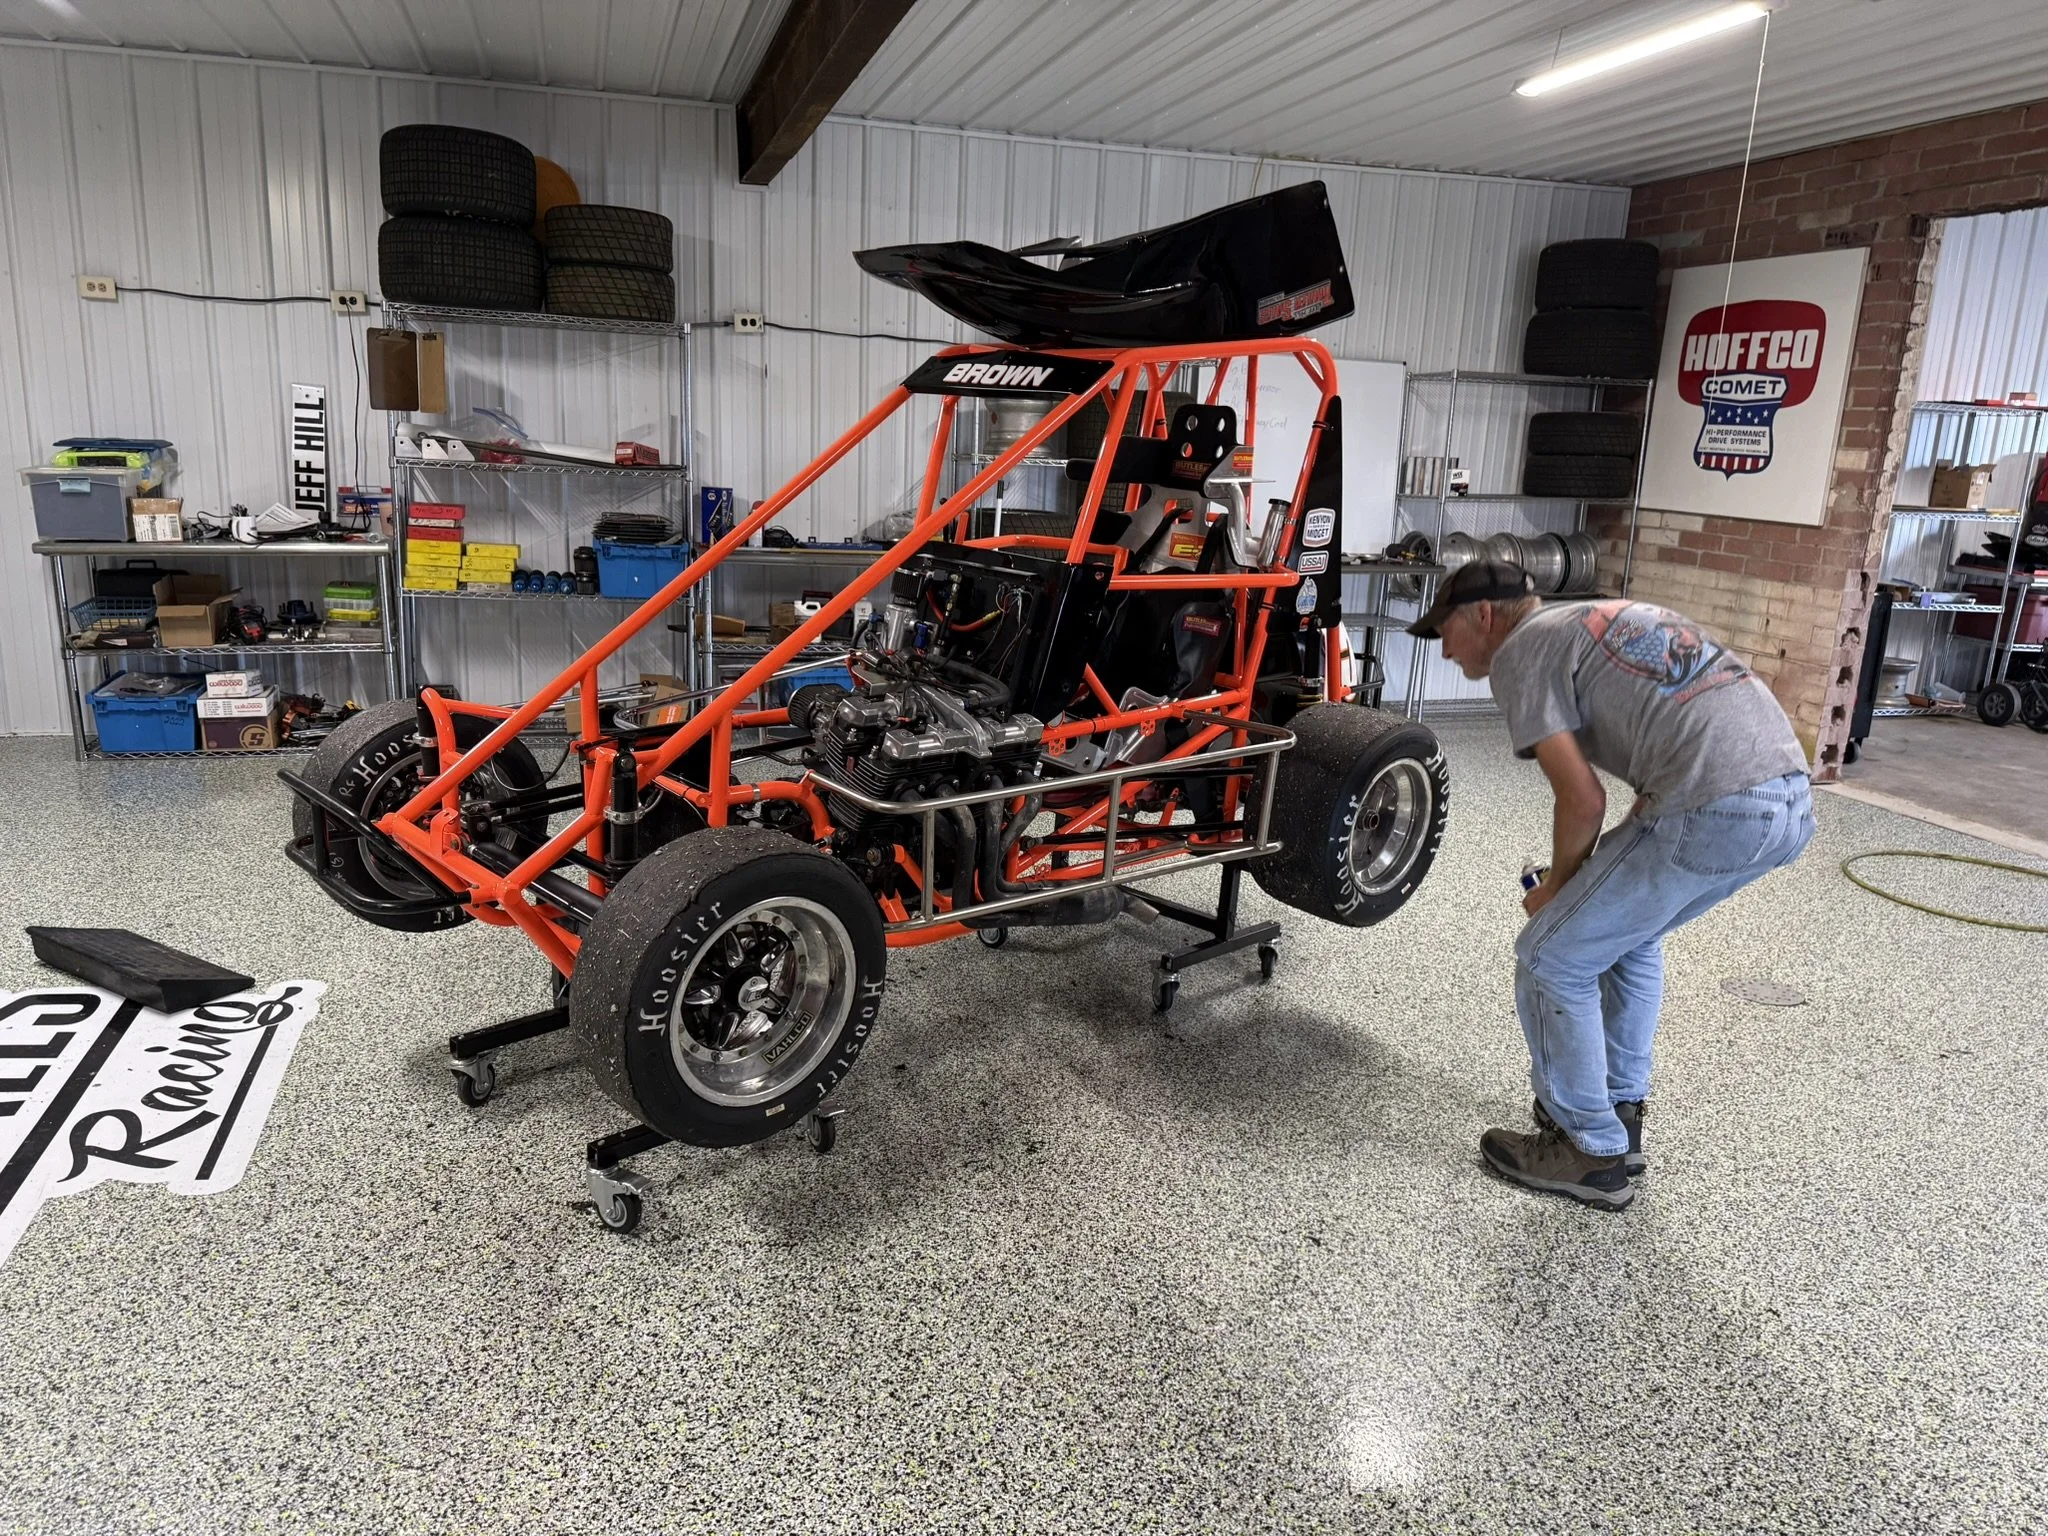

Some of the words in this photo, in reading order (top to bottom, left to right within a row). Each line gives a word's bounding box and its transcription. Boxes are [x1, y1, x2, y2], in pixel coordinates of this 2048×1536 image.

[1683, 329, 1819, 371] HOFFCO
[943, 363, 1055, 386] BROWN
[1705, 380, 1781, 395] COMET
[294, 397, 324, 452] HILL
[1708, 436, 1728, 444] DRIVE
[1730, 438, 1762, 446] SYSTEMS
[294, 460, 325, 512] JEFF
[1306, 528, 1329, 539] MIDGET
[1308, 514, 1332, 525] KENYON
[638, 902, 722, 1037] Hoosier
[766, 1013, 811, 1060] VAHLCO
[57, 986, 303, 1183] Racing
